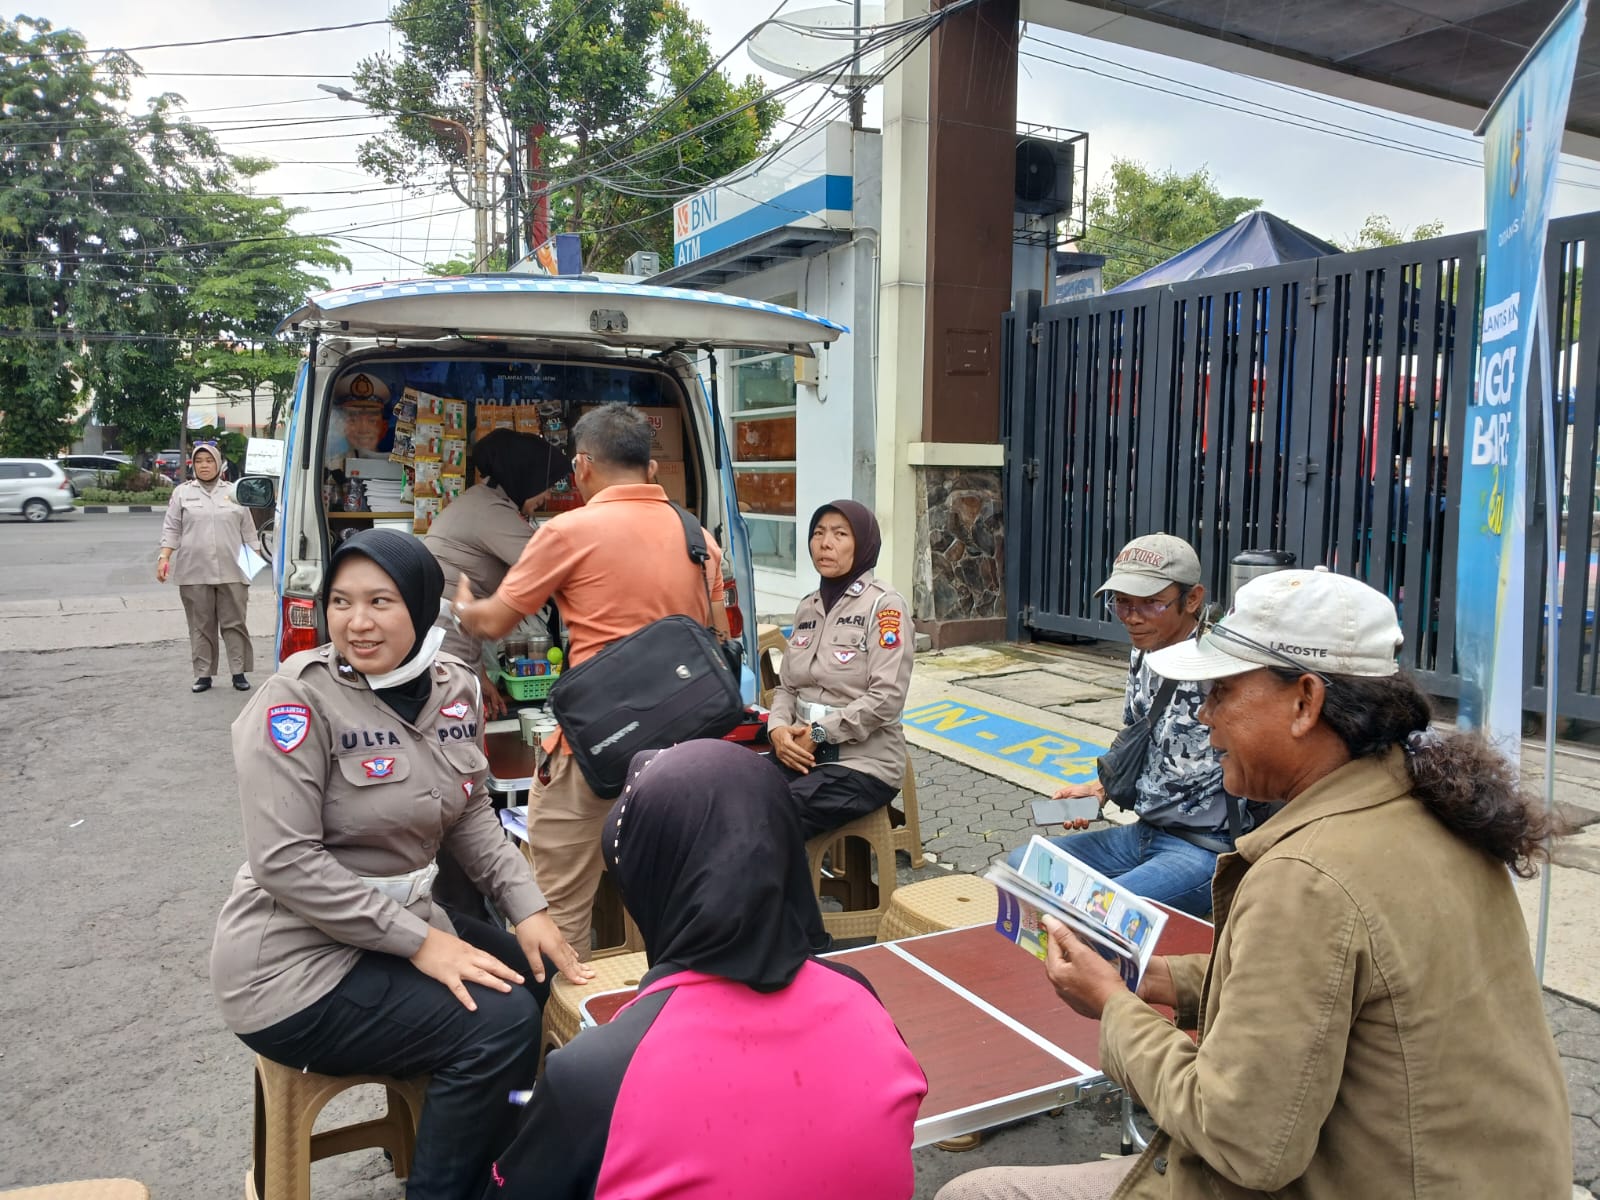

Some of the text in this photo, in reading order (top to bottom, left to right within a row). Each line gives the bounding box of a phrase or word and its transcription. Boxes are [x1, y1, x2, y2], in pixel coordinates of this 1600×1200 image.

[691, 189, 718, 231] BNI
[678, 235, 701, 266] ATM
[1132, 547, 1165, 568] YORK
[1269, 641, 1329, 658] LACOSTE
[340, 730, 401, 750] ULFA
